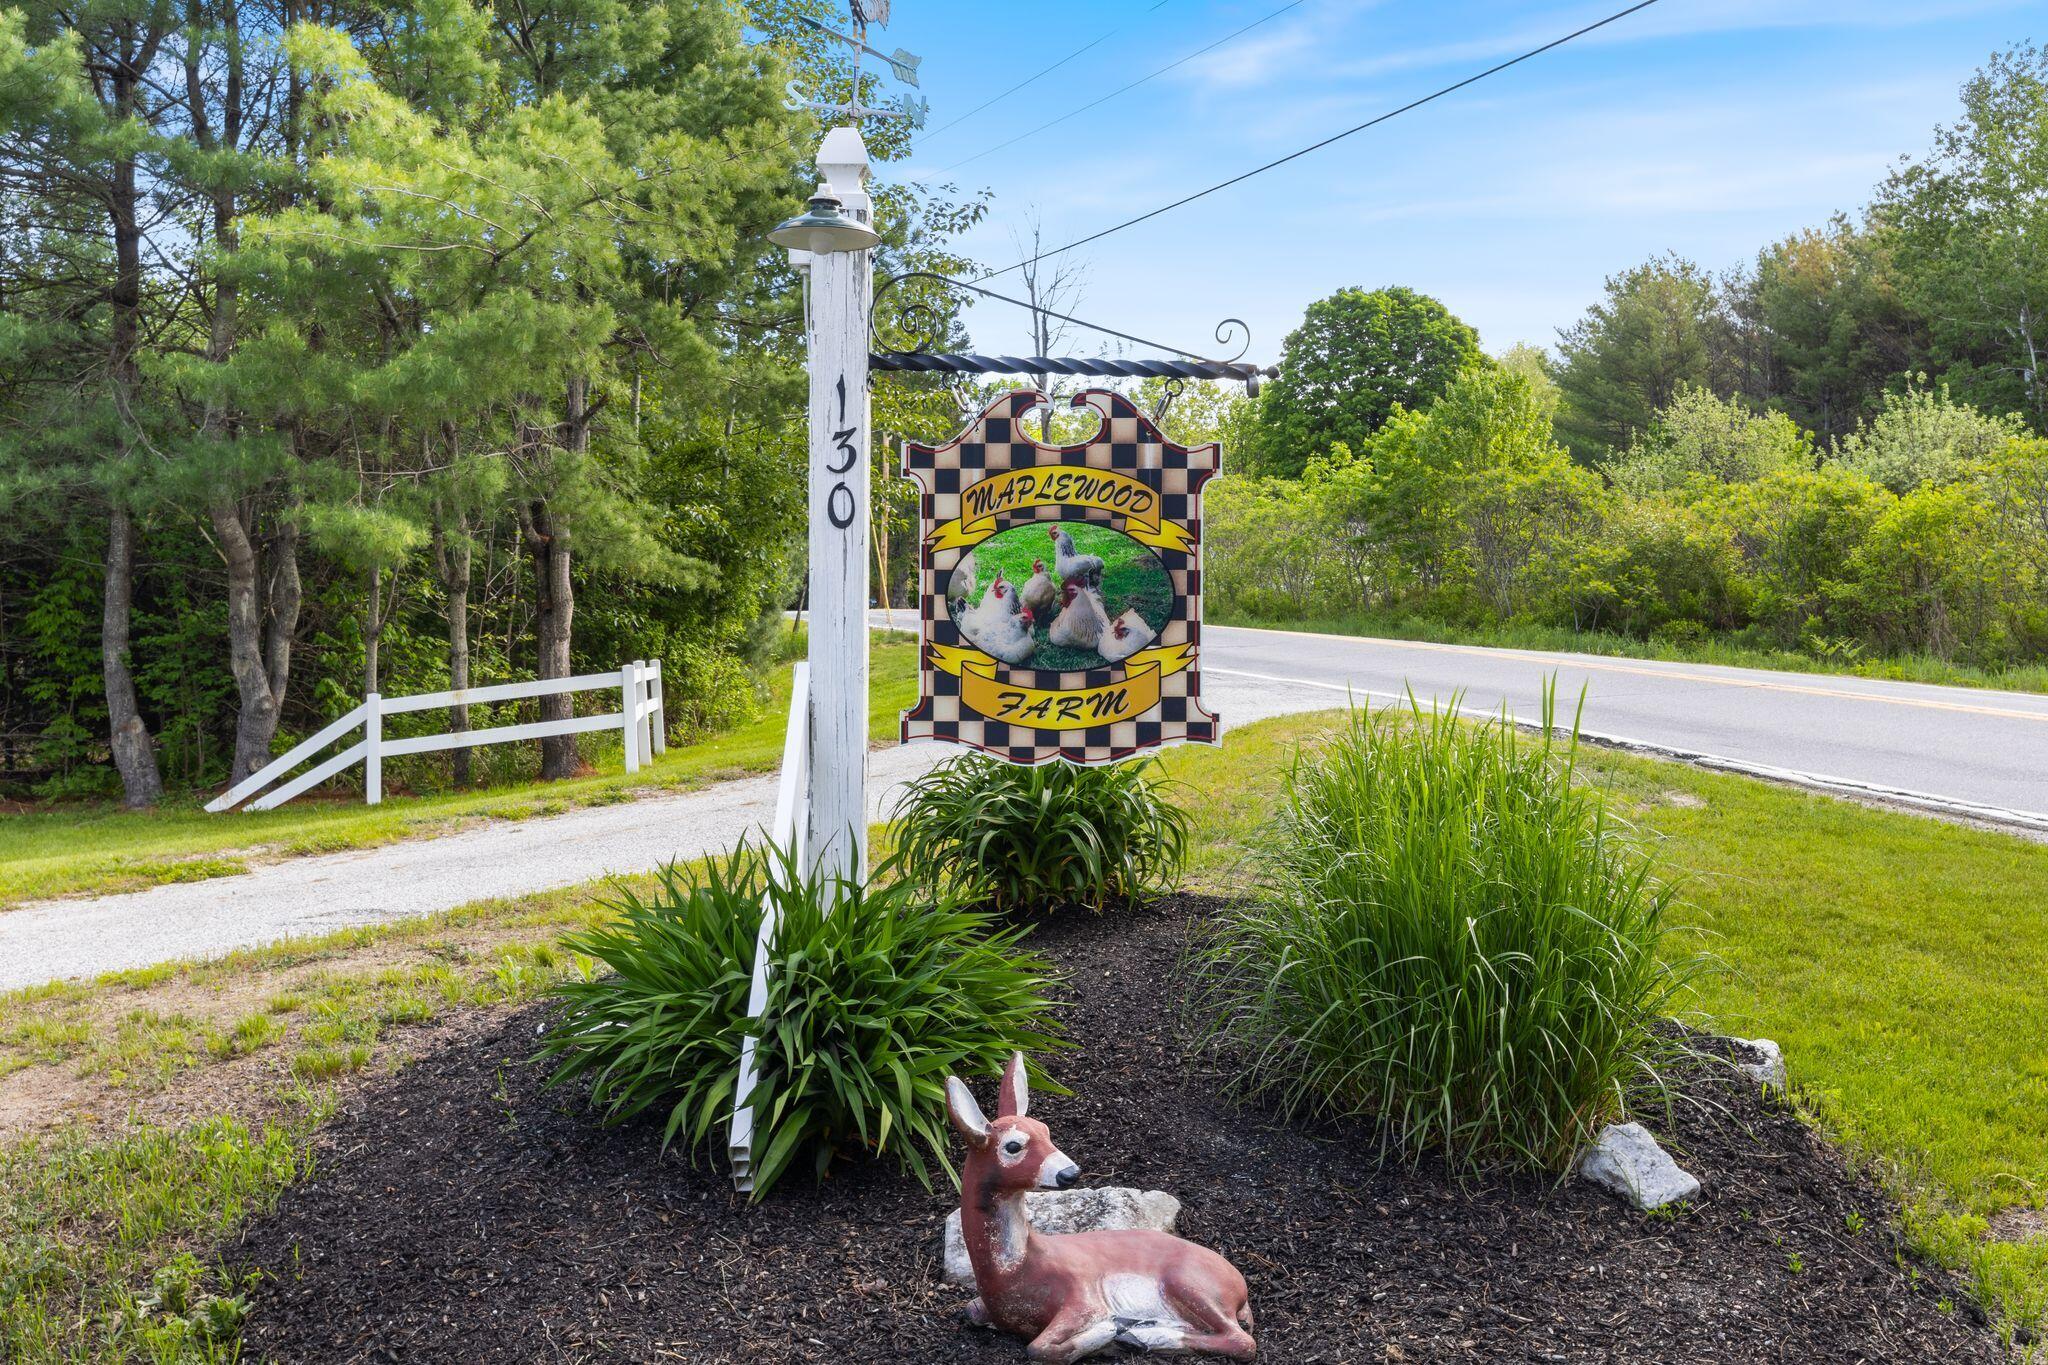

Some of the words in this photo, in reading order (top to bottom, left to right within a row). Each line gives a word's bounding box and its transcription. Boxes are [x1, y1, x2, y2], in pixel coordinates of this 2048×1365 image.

[781, 79, 806, 111] S
[903, 93, 927, 126] N
[826, 374, 858, 529] 130
[966, 474, 1153, 515] MAPLEWOOD
[997, 688, 1129, 721] FARM
